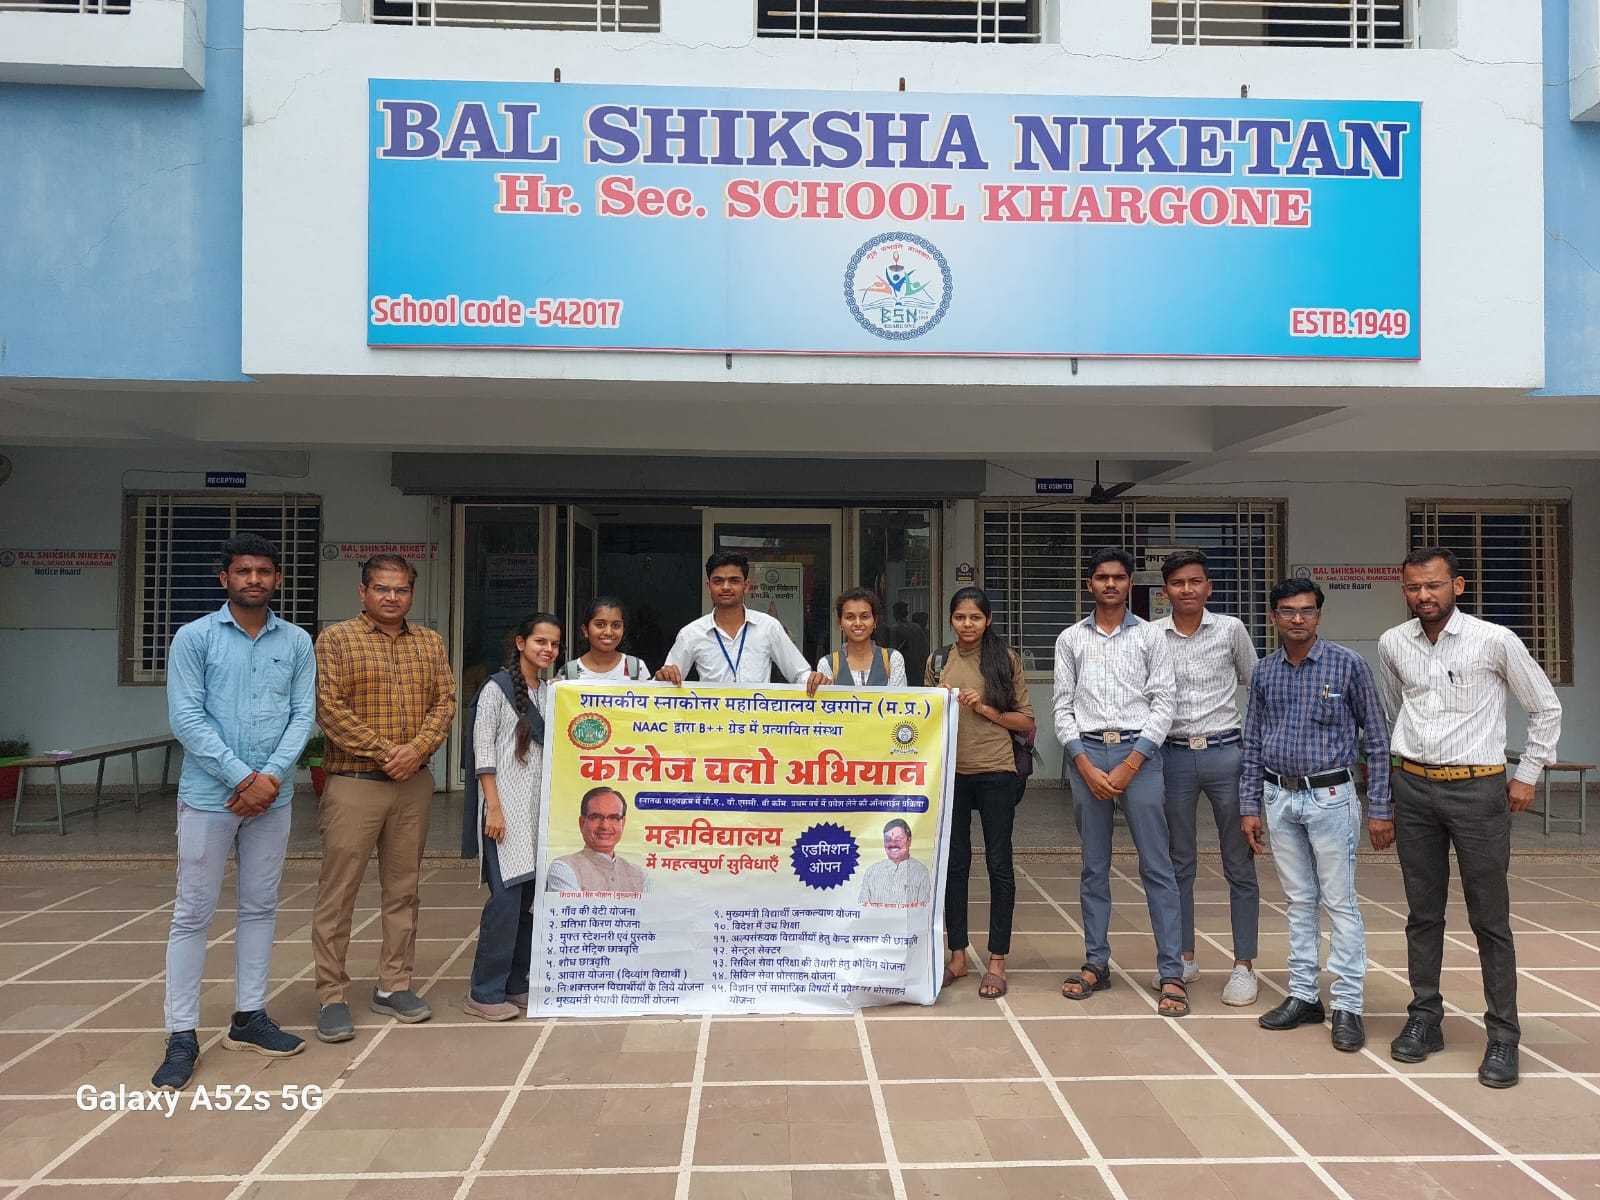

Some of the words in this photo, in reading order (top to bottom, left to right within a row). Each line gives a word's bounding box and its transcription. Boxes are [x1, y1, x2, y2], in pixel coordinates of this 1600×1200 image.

[378, 99, 559, 162] BAL
[585, 103, 990, 171] SHIKSHA
[1011, 114, 1409, 179] NIKETAN
[495, 173, 581, 216] Hr.
[599, 175, 707, 219] Sec.
[725, 178, 966, 222] SCHOOL
[983, 183, 1311, 228] KHARGONE
[372, 295, 458, 326] School
[462, 297, 524, 327] code
[527, 299, 622, 329] -542017
[881, 307, 918, 324] BSN
[207, 477, 245, 485] RECEPTION
[359, 544, 396, 552] SHIKSHA
[399, 544, 438, 552] NIKETN
[38, 551, 76, 560] SHIKSHA
[78, 552, 117, 560] NIKETAN
[34, 567, 58, 576] Notice
[60, 567, 81, 576] Board
[1312, 567, 1328, 575] BAL
[1331, 567, 1366, 575] SHIKSHA
[1367, 567, 1403, 575] NIKETAN
[1328, 582, 1351, 590] Notice
[1352, 582, 1372, 590] Board
[580, 691, 649, 708] शासकीय
[725, 693, 817, 713] महाविद्यालय
[821, 696, 873, 714] खरगोन
[632, 721, 668, 733] NAAC
[674, 722, 696, 735] द्वारा
[699, 722, 724, 733] B++
[728, 720, 746, 735] ग्रेड
[749, 720, 761, 734] में
[762, 721, 810, 736] प्रत्यायित
[813, 721, 844, 736] संस्था
[579, 745, 697, 782] कॉलेज
[704, 747, 778, 785] चलो
[786, 748, 928, 787] अभियान
[645, 817, 784, 849] महाविद्यालय
[801, 840, 851, 857] एडमिशन
[646, 853, 658, 868] में
[808, 859, 842, 874] ओपन
[562, 905, 577, 916] गाँव
[579, 905, 590, 916] की
[592, 905, 607, 916] बेटी
[609, 906, 636, 916] योजना
[792, 908, 833, 918] जनकल्याण
[836, 906, 861, 919] योजना
[561, 917, 587, 929] प्रतिभा
[589, 917, 612, 929] किरण
[614, 918, 640, 929] योजना
[732, 920, 754, 930] विदेश
[780, 919, 800, 930] शिक्षा
[582, 931, 615, 941] स्टेशनरी
[617, 931, 628, 942] एवं
[731, 932, 778, 943] अल्पसंख्यक
[852, 935, 879, 944] सरकार
[560, 943, 580, 954] पोस्ट
[730, 957, 755, 967] सिविल
[758, 957, 774, 967] सेवा
[801, 956, 811, 968] की
[880, 959, 906, 971] योजना
[558, 970, 585, 980] आवास
[588, 968, 614, 980] योजना
[652, 967, 681, 979] विद्यार्थी
[730, 969, 755, 980] सिविल
[811, 969, 836, 980] योजना
[648, 981, 656, 991] के
[659, 980, 675, 991] लिये
[677, 980, 704, 991] योजना
[770, 982, 806, 993] सामाजिक
[652, 994, 680, 1005] योजना
[729, 994, 756, 1005] योजना
